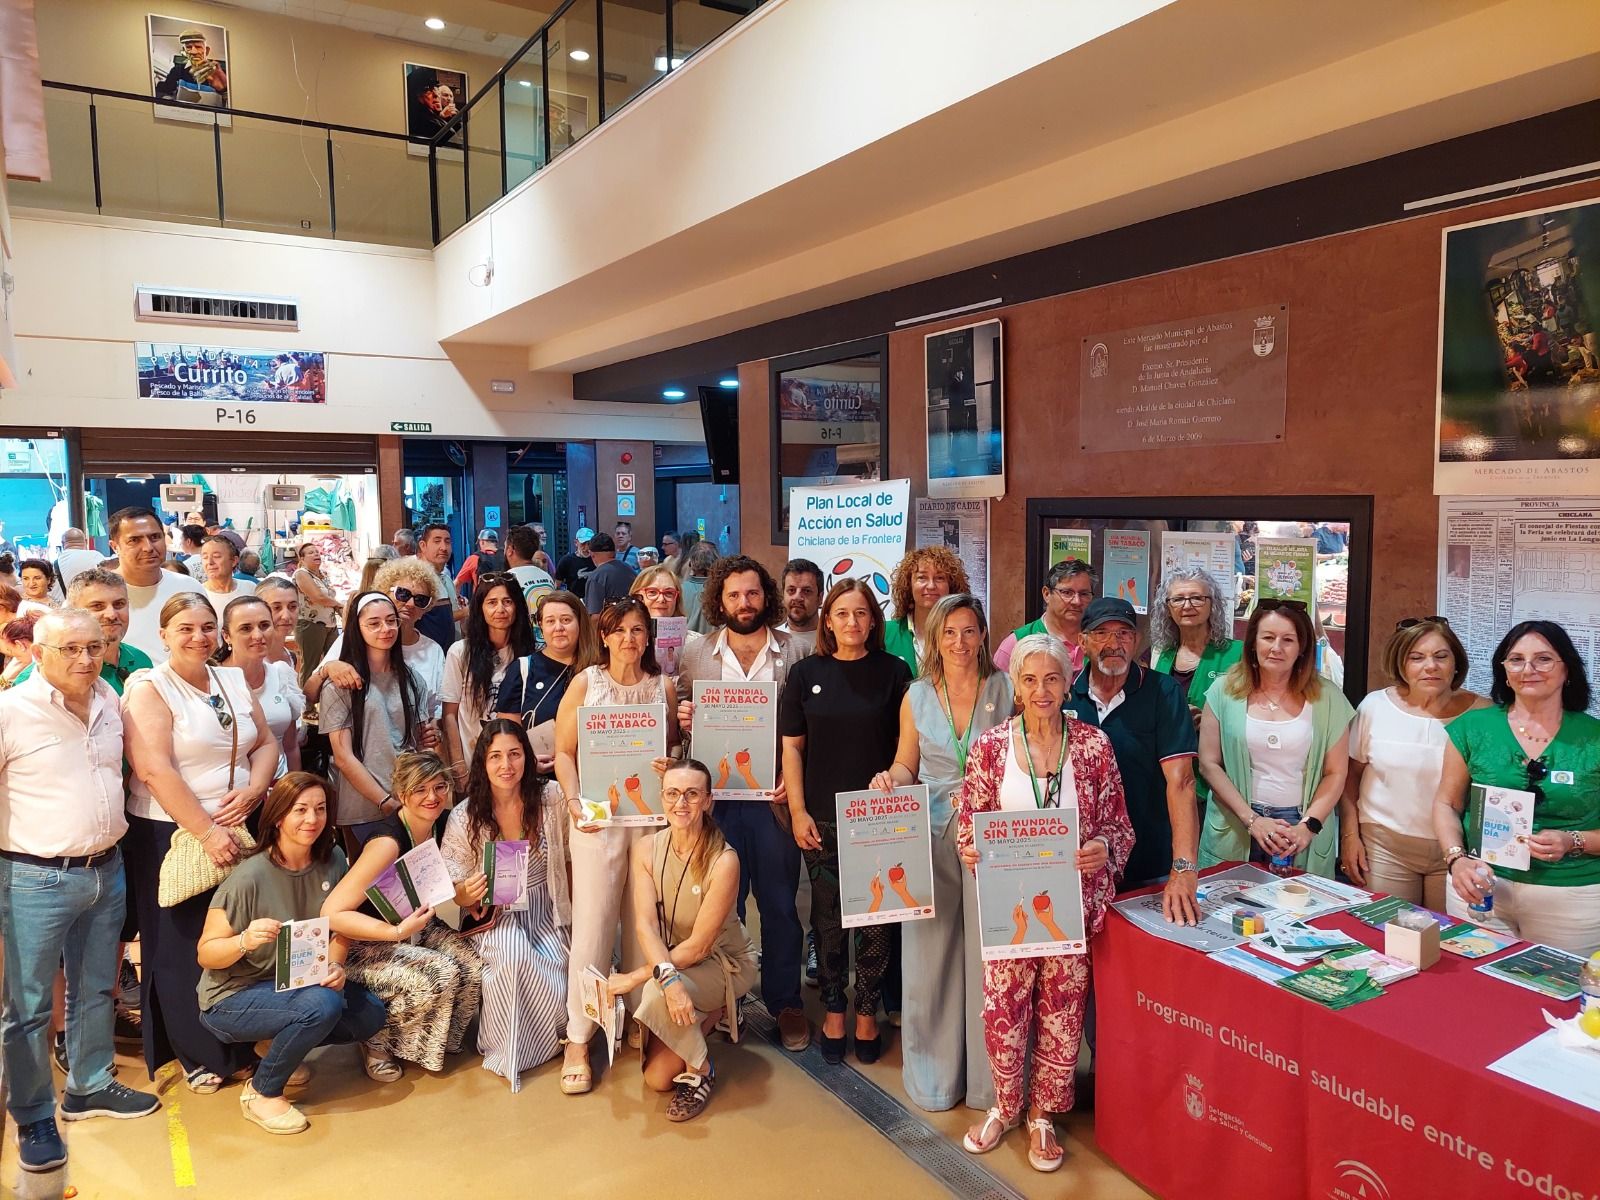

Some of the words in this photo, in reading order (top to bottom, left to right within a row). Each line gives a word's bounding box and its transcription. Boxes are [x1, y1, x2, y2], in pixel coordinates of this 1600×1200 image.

[1137, 334, 1163, 344] Mercado
[1164, 327, 1196, 339] Municipal
[1197, 325, 1205, 334] de
[1207, 321, 1233, 333] Abastos
[1154, 339, 1188, 351] inaugurado
[1189, 338, 1201, 347] por
[1201, 335, 1208, 344] el
[150, 350, 259, 369] PESCADERÍA
[1176, 356, 1209, 367] Presidente
[174, 362, 248, 385] Currito
[1153, 370, 1170, 380] Junta
[150, 382, 176, 391] Pescado
[1140, 383, 1163, 392] Manuel
[1164, 380, 1187, 390] Chaves
[1188, 376, 1219, 387] González
[1158, 402, 1167, 410] de
[1167, 401, 1174, 409] la
[1174, 399, 1196, 409] ciudad
[1197, 398, 1205, 407] de
[1206, 396, 1236, 407] Chiclana
[216, 408, 256, 424] P-16
[1168, 415, 1191, 425] Román
[1192, 414, 1222, 424] Guerrero
[403, 423, 430, 431] SALIDA
[1156, 433, 1176, 443] Marzo
[1177, 433, 1185, 441] de
[1474, 467, 1522, 476] MERCADO
[1544, 465, 1590, 474] ABASTOS
[806, 496, 833, 510] Plan
[837, 492, 872, 509] Local
[876, 491, 893, 506] de
[920, 502, 945, 511] DIARIO
[798, 513, 841, 530] Acción
[846, 516, 862, 528] en
[866, 512, 903, 528] Salud
[797, 535, 836, 547] Chiclana
[837, 535, 850, 545] de
[852, 535, 860, 545] la
[862, 533, 902, 545] Frontera
[1053, 541, 1068, 550] SIN
[705, 687, 721, 695] DÍA
[700, 695, 720, 704] SIN
[724, 695, 769, 704] TABACO
[591, 713, 607, 721] DÍA
[609, 711, 652, 720] MUNDIAL
[586, 720, 606, 730] SIN
[610, 718, 657, 729] TABACO
[850, 799, 866, 808] DÍA
[870, 794, 915, 805] MUNDIAL
[845, 807, 867, 818] SIN
[871, 802, 921, 816] TABACO
[989, 819, 1008, 829] DÍA
[1011, 817, 1063, 828] MUNDIAL
[1484, 821, 1511, 833] BUEN
[983, 828, 1007, 840] SIN
[1012, 825, 1069, 838] TABACO
[1484, 829, 1499, 838] DÍA
[291, 950, 313, 960] BUEN
[291, 958, 305, 967] DÍA
[1136, 990, 1214, 1039] Programa
[1219, 1026, 1300, 1076] Chiclana
[1311, 1068, 1416, 1133] saludable
[1423, 1123, 1495, 1171] entre
[1208, 1104, 1245, 1127] Delegación
[1208, 1113, 1219, 1123] de
[1219, 1116, 1239, 1132] Salud
[1239, 1128, 1245, 1136] y
[1244, 1130, 1273, 1152] Consumo
[1332, 1187, 1352, 1200] JUNTA
